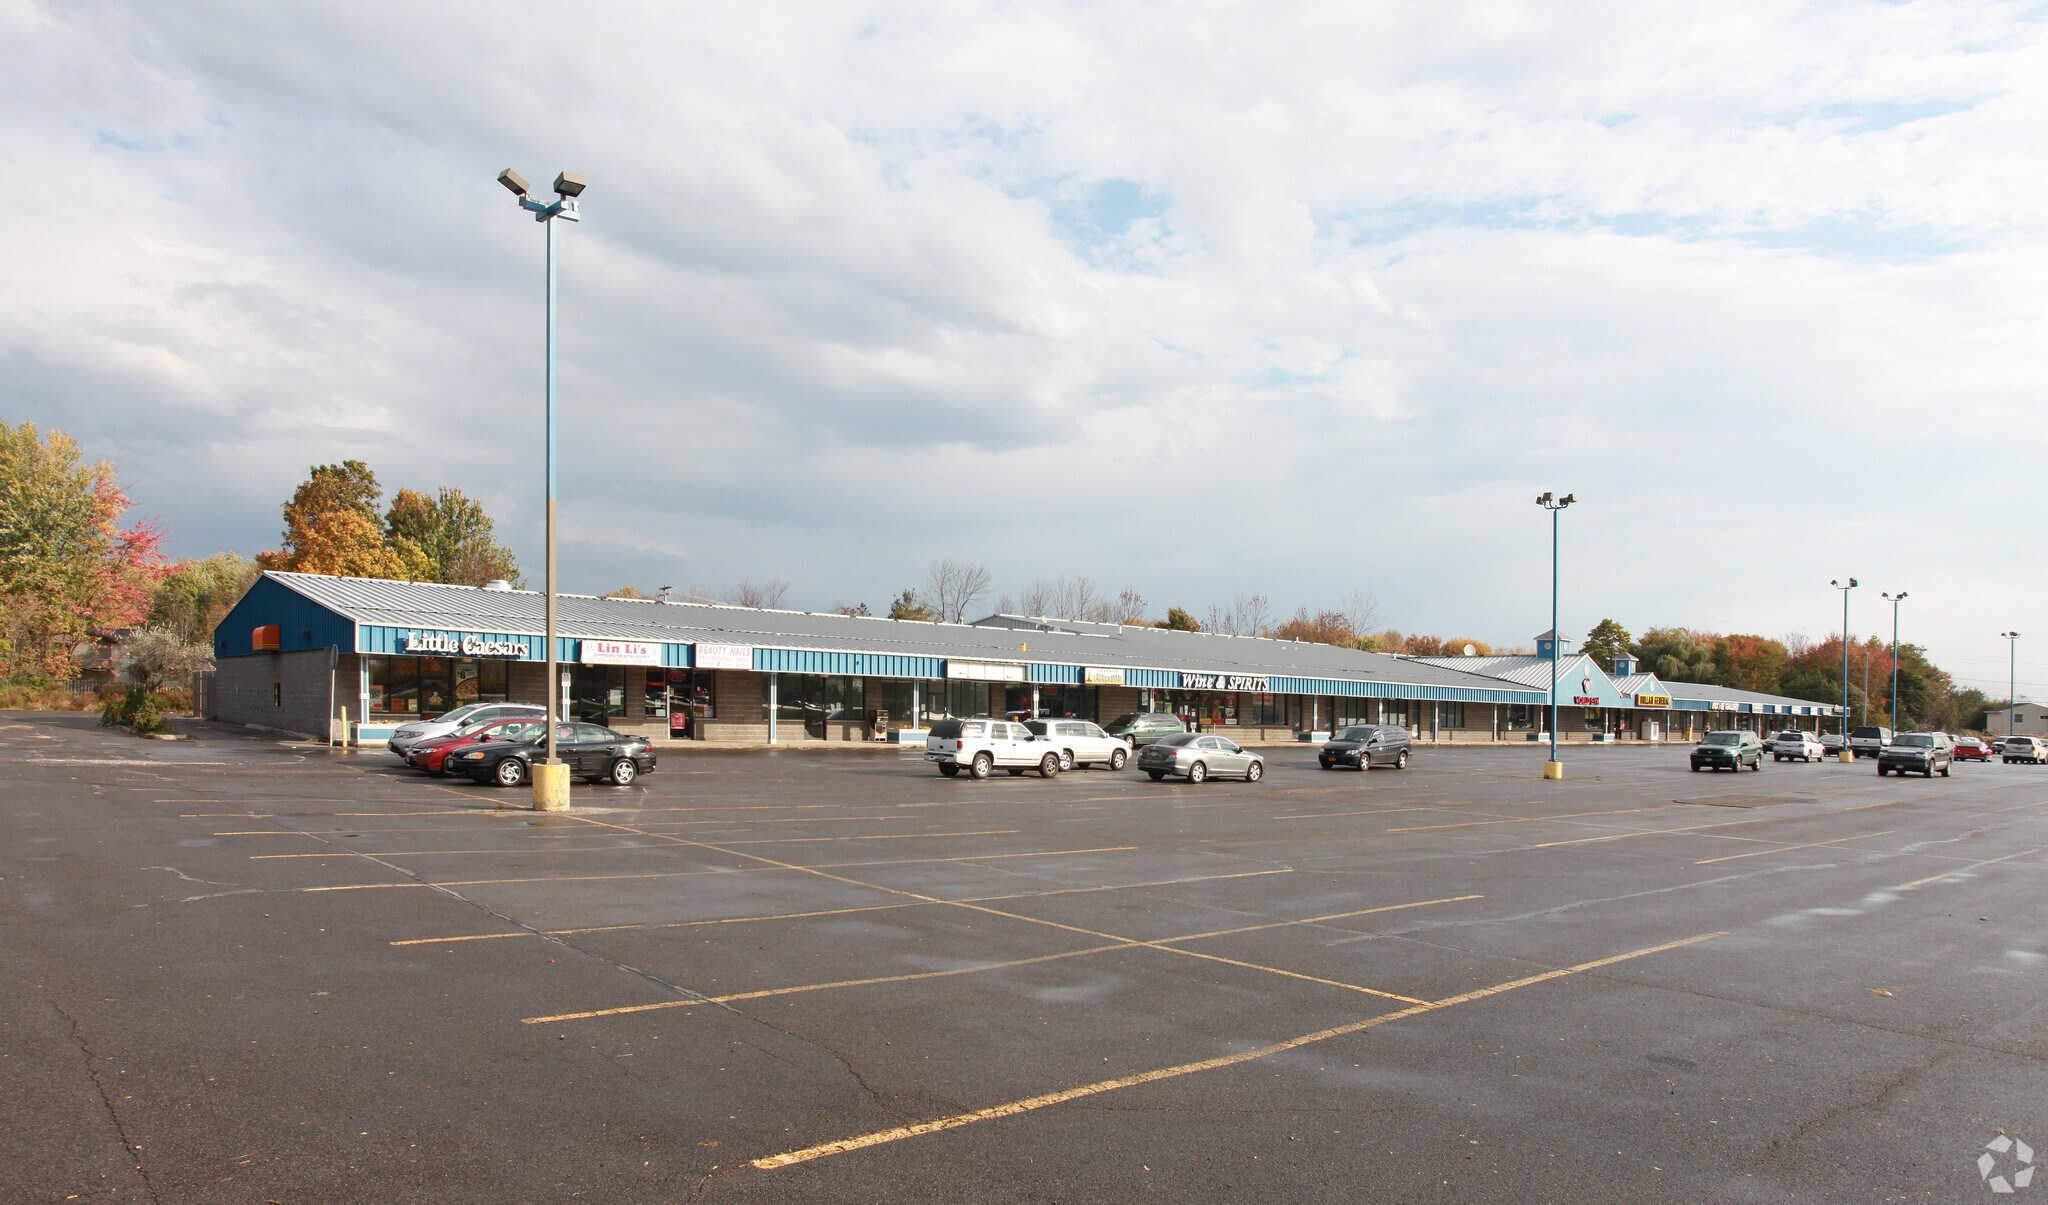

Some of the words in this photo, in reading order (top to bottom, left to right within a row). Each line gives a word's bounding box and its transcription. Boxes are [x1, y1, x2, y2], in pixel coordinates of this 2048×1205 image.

[406, 632, 459, 653] Little
[462, 635, 530, 656] Caesars
[598, 643, 620, 653] Lin
[625, 644, 647, 655] Li's
[699, 645, 727, 655] BEAUTY
[730, 647, 751, 656] NAILS
[1182, 673, 1213, 689] Wine
[1216, 675, 1226, 690] &
[1228, 676, 1268, 691] SPIRITS
